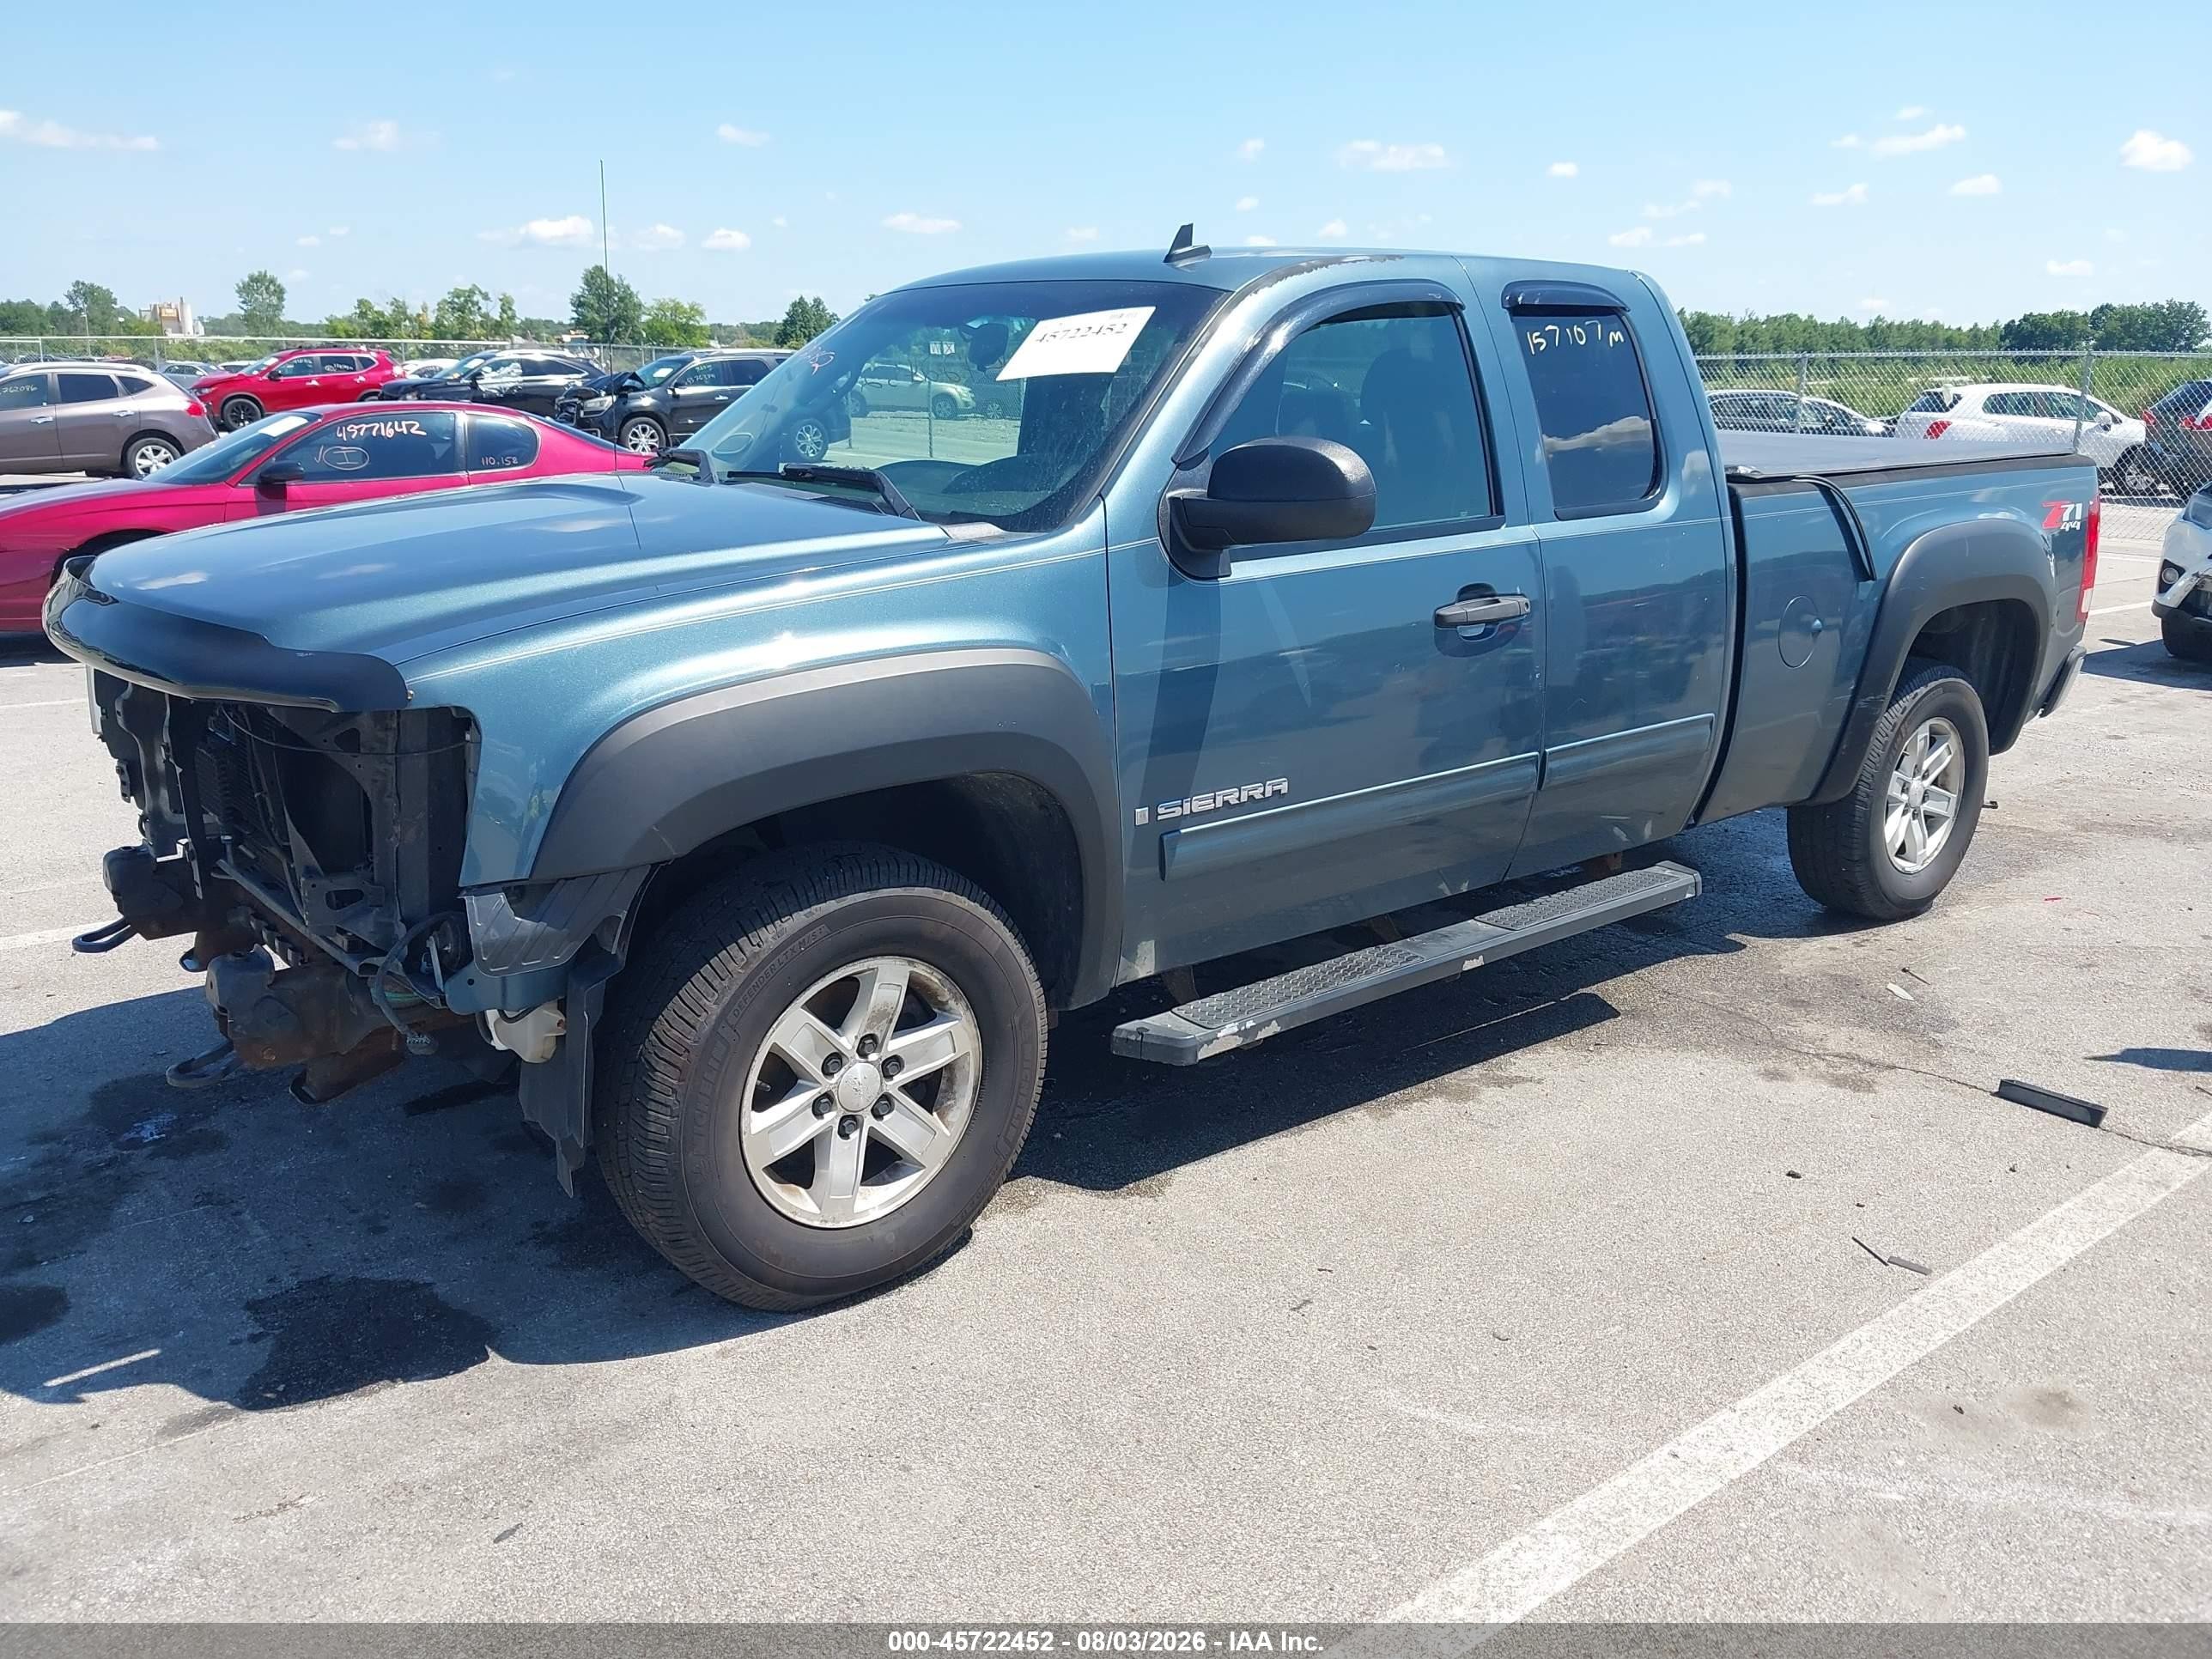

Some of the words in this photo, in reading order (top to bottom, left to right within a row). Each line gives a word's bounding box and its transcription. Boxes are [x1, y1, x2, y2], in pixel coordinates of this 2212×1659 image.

[1035, 323, 1127, 343] 45722452
[1527, 320, 1601, 355] 157107
[2041, 501, 2083, 529] Z71
[1157, 777, 1289, 821] SIERRA
[732, 963, 778, 1019] DEFENDER
[777, 946, 798, 966] LTX
